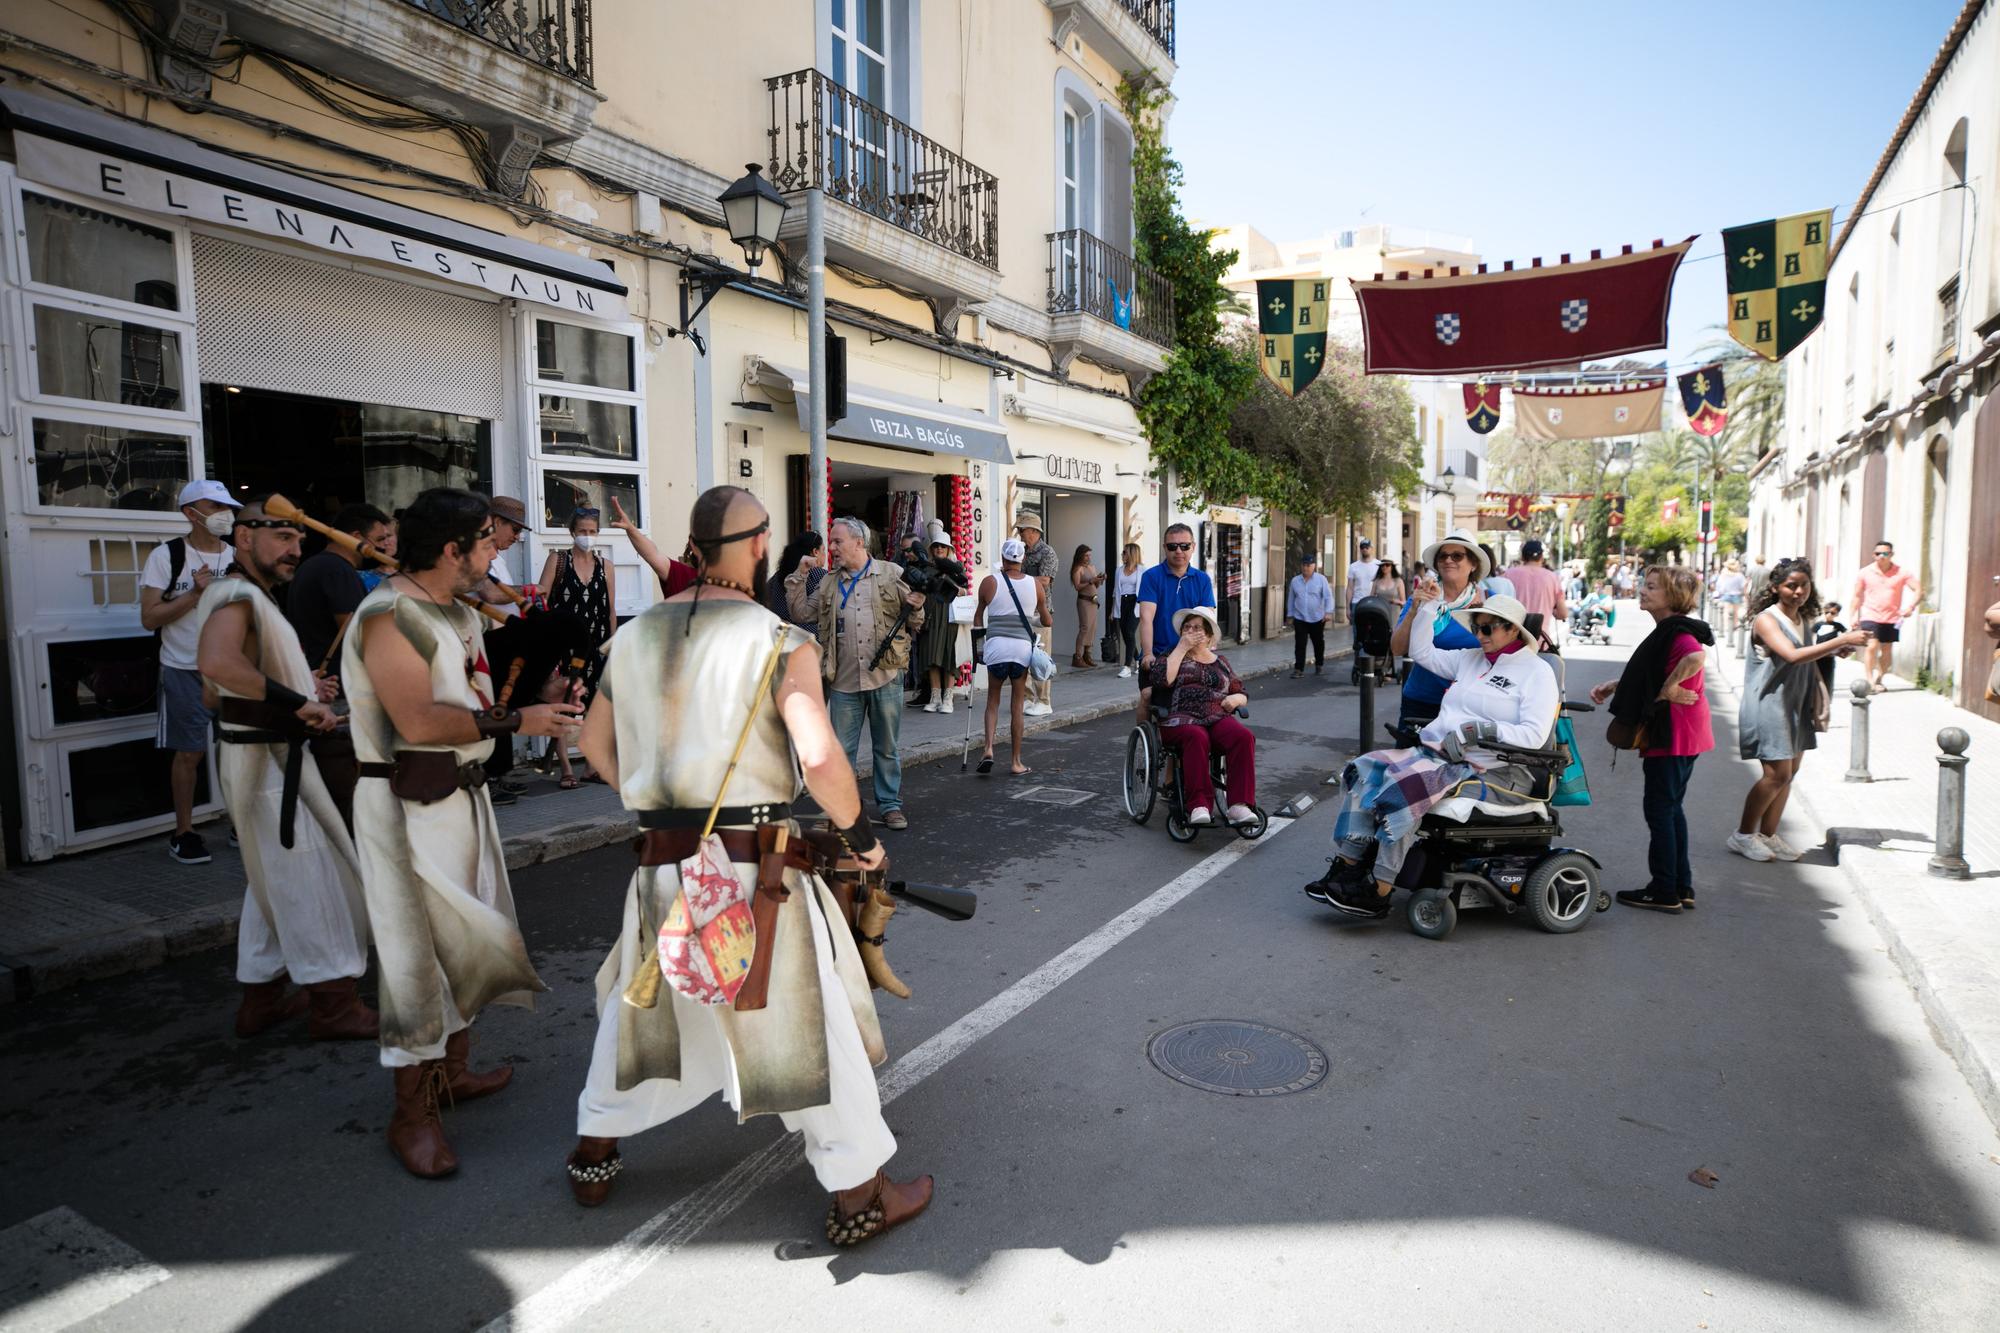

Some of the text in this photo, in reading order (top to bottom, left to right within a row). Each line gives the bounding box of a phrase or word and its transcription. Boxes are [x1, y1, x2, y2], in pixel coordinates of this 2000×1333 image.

[870, 417, 965, 449] IBIZA BAGÚS
[740, 429, 753, 492] IB
[1046, 453, 1102, 484] OLIVER
